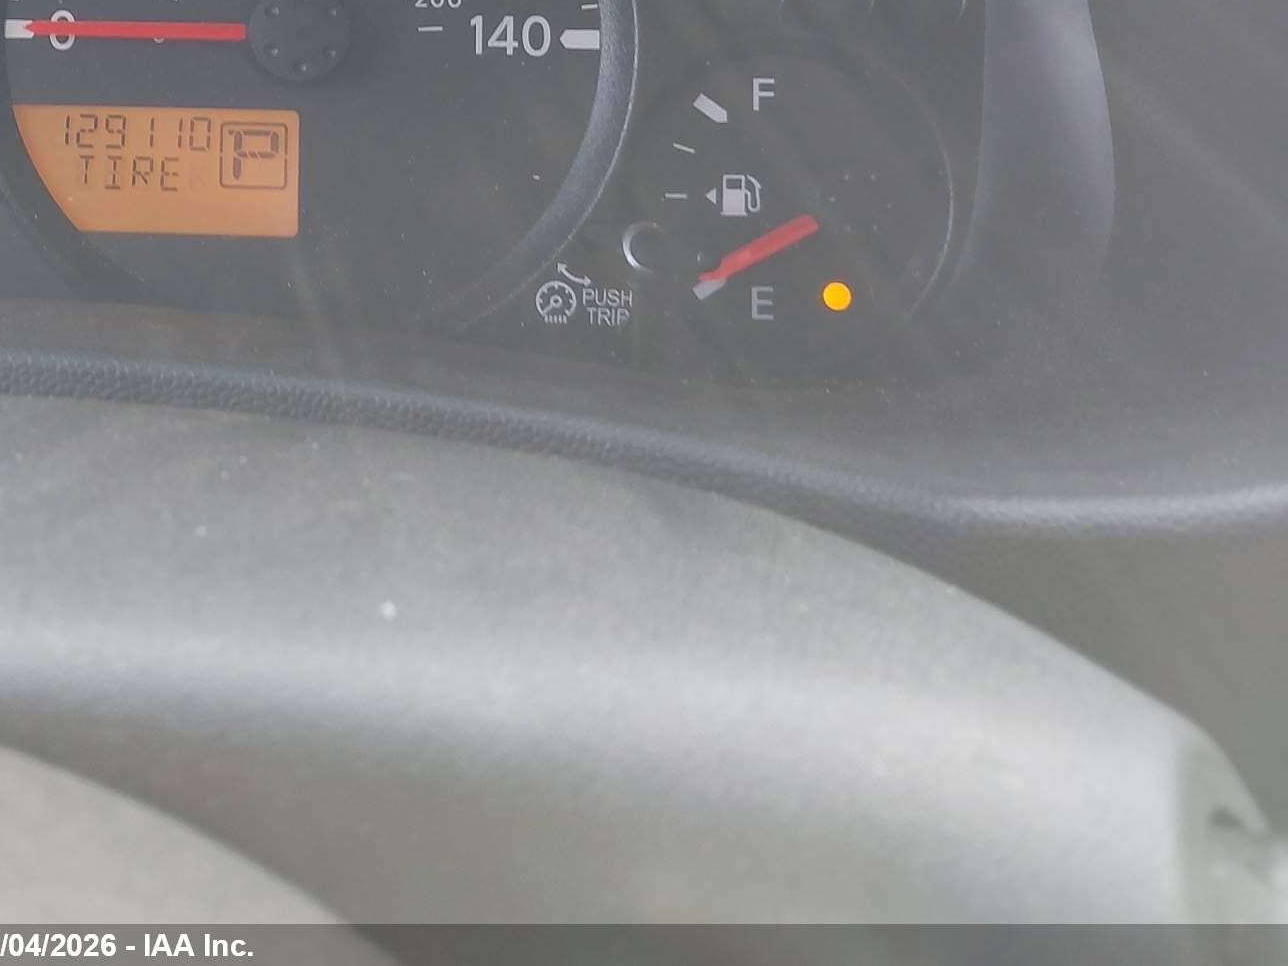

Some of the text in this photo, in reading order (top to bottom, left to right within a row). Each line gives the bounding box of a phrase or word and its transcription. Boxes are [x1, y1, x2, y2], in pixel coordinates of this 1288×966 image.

[49, 10, 76, 51] 0
[470, 15, 551, 57] 140
[753, 78, 775, 111] F
[64, 114, 211, 151] 129110
[228, 129, 279, 179] P
[80, 155, 180, 192] TIRE
[582, 289, 633, 307] PUSH
[751, 286, 774, 320] E
[586, 308, 631, 326] TRIP
